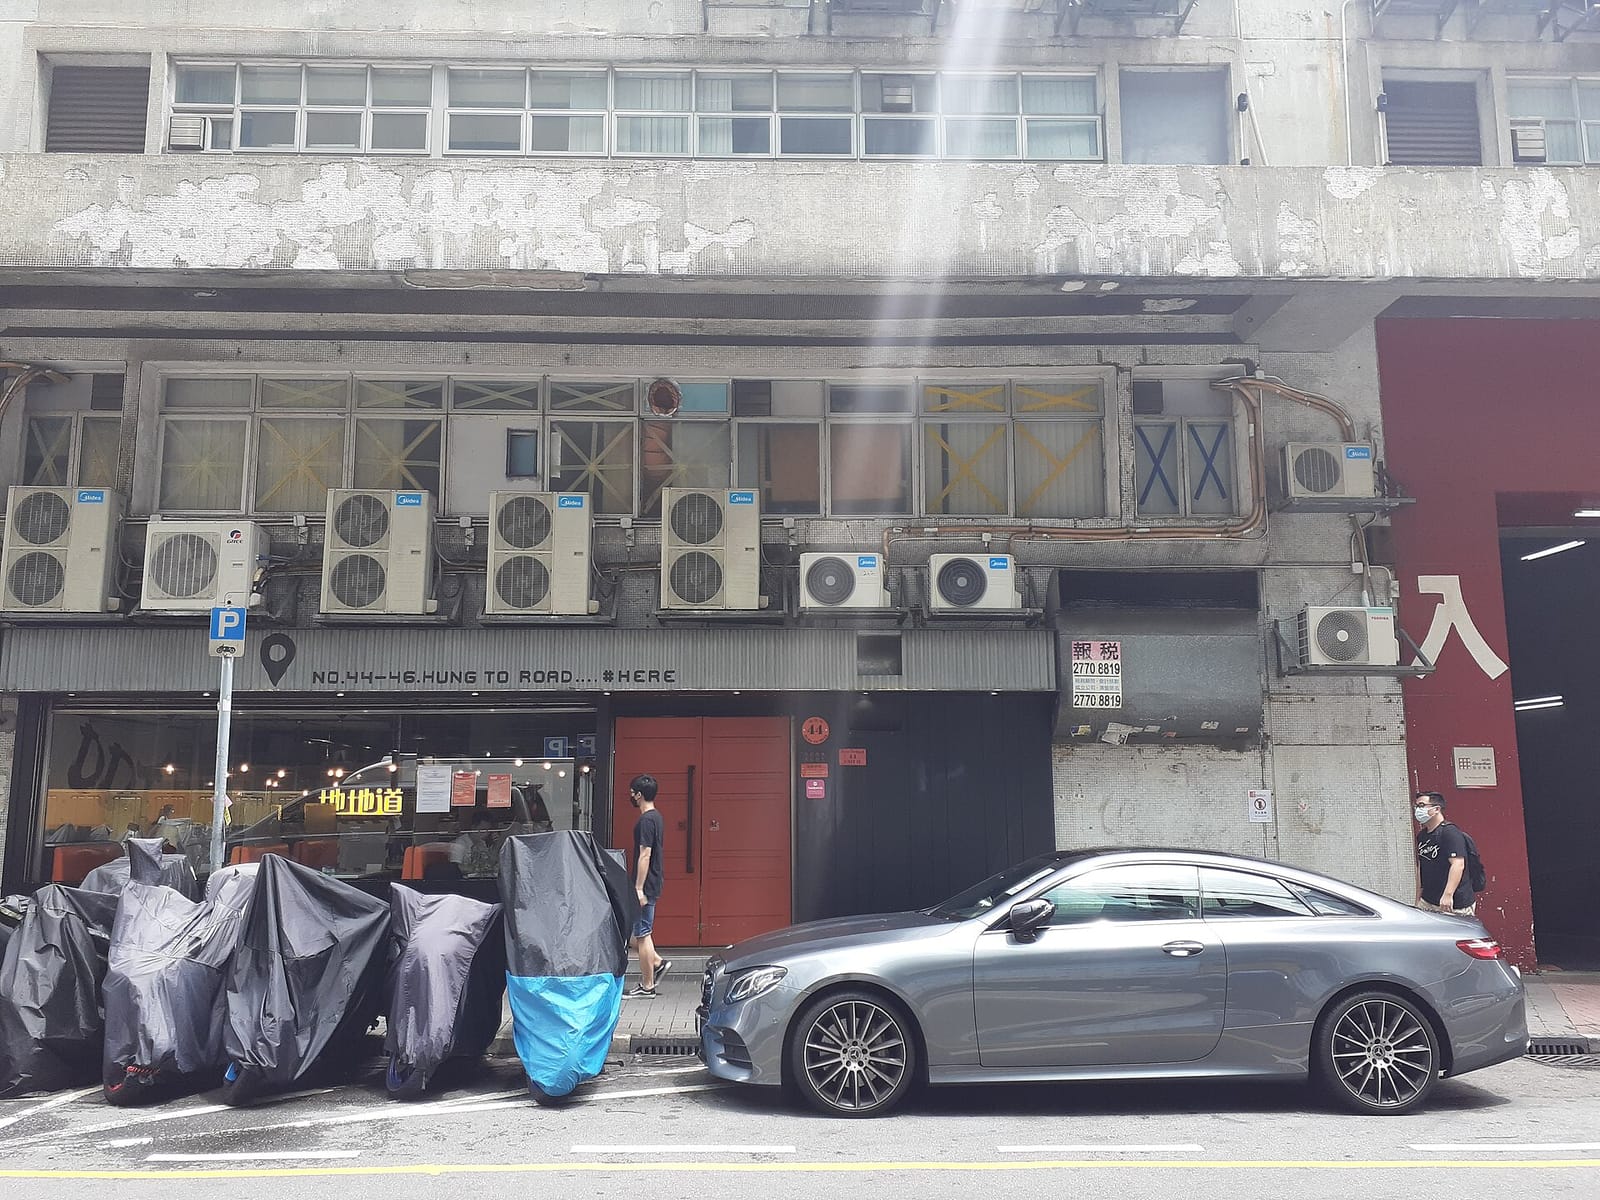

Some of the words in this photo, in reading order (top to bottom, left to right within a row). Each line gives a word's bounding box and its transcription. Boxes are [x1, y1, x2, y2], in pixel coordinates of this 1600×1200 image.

[218, 611, 240, 637] P
[1411, 575, 1509, 679] 入
[1073, 662, 1095, 674] 2770
[1098, 662, 1120, 675] 8819
[484, 670, 509, 684] TO
[1074, 694, 1096, 706] 2770
[1099, 694, 1121, 707] 8819
[807, 724, 824, 735] 44
[318, 788, 404, 816] 地地道
